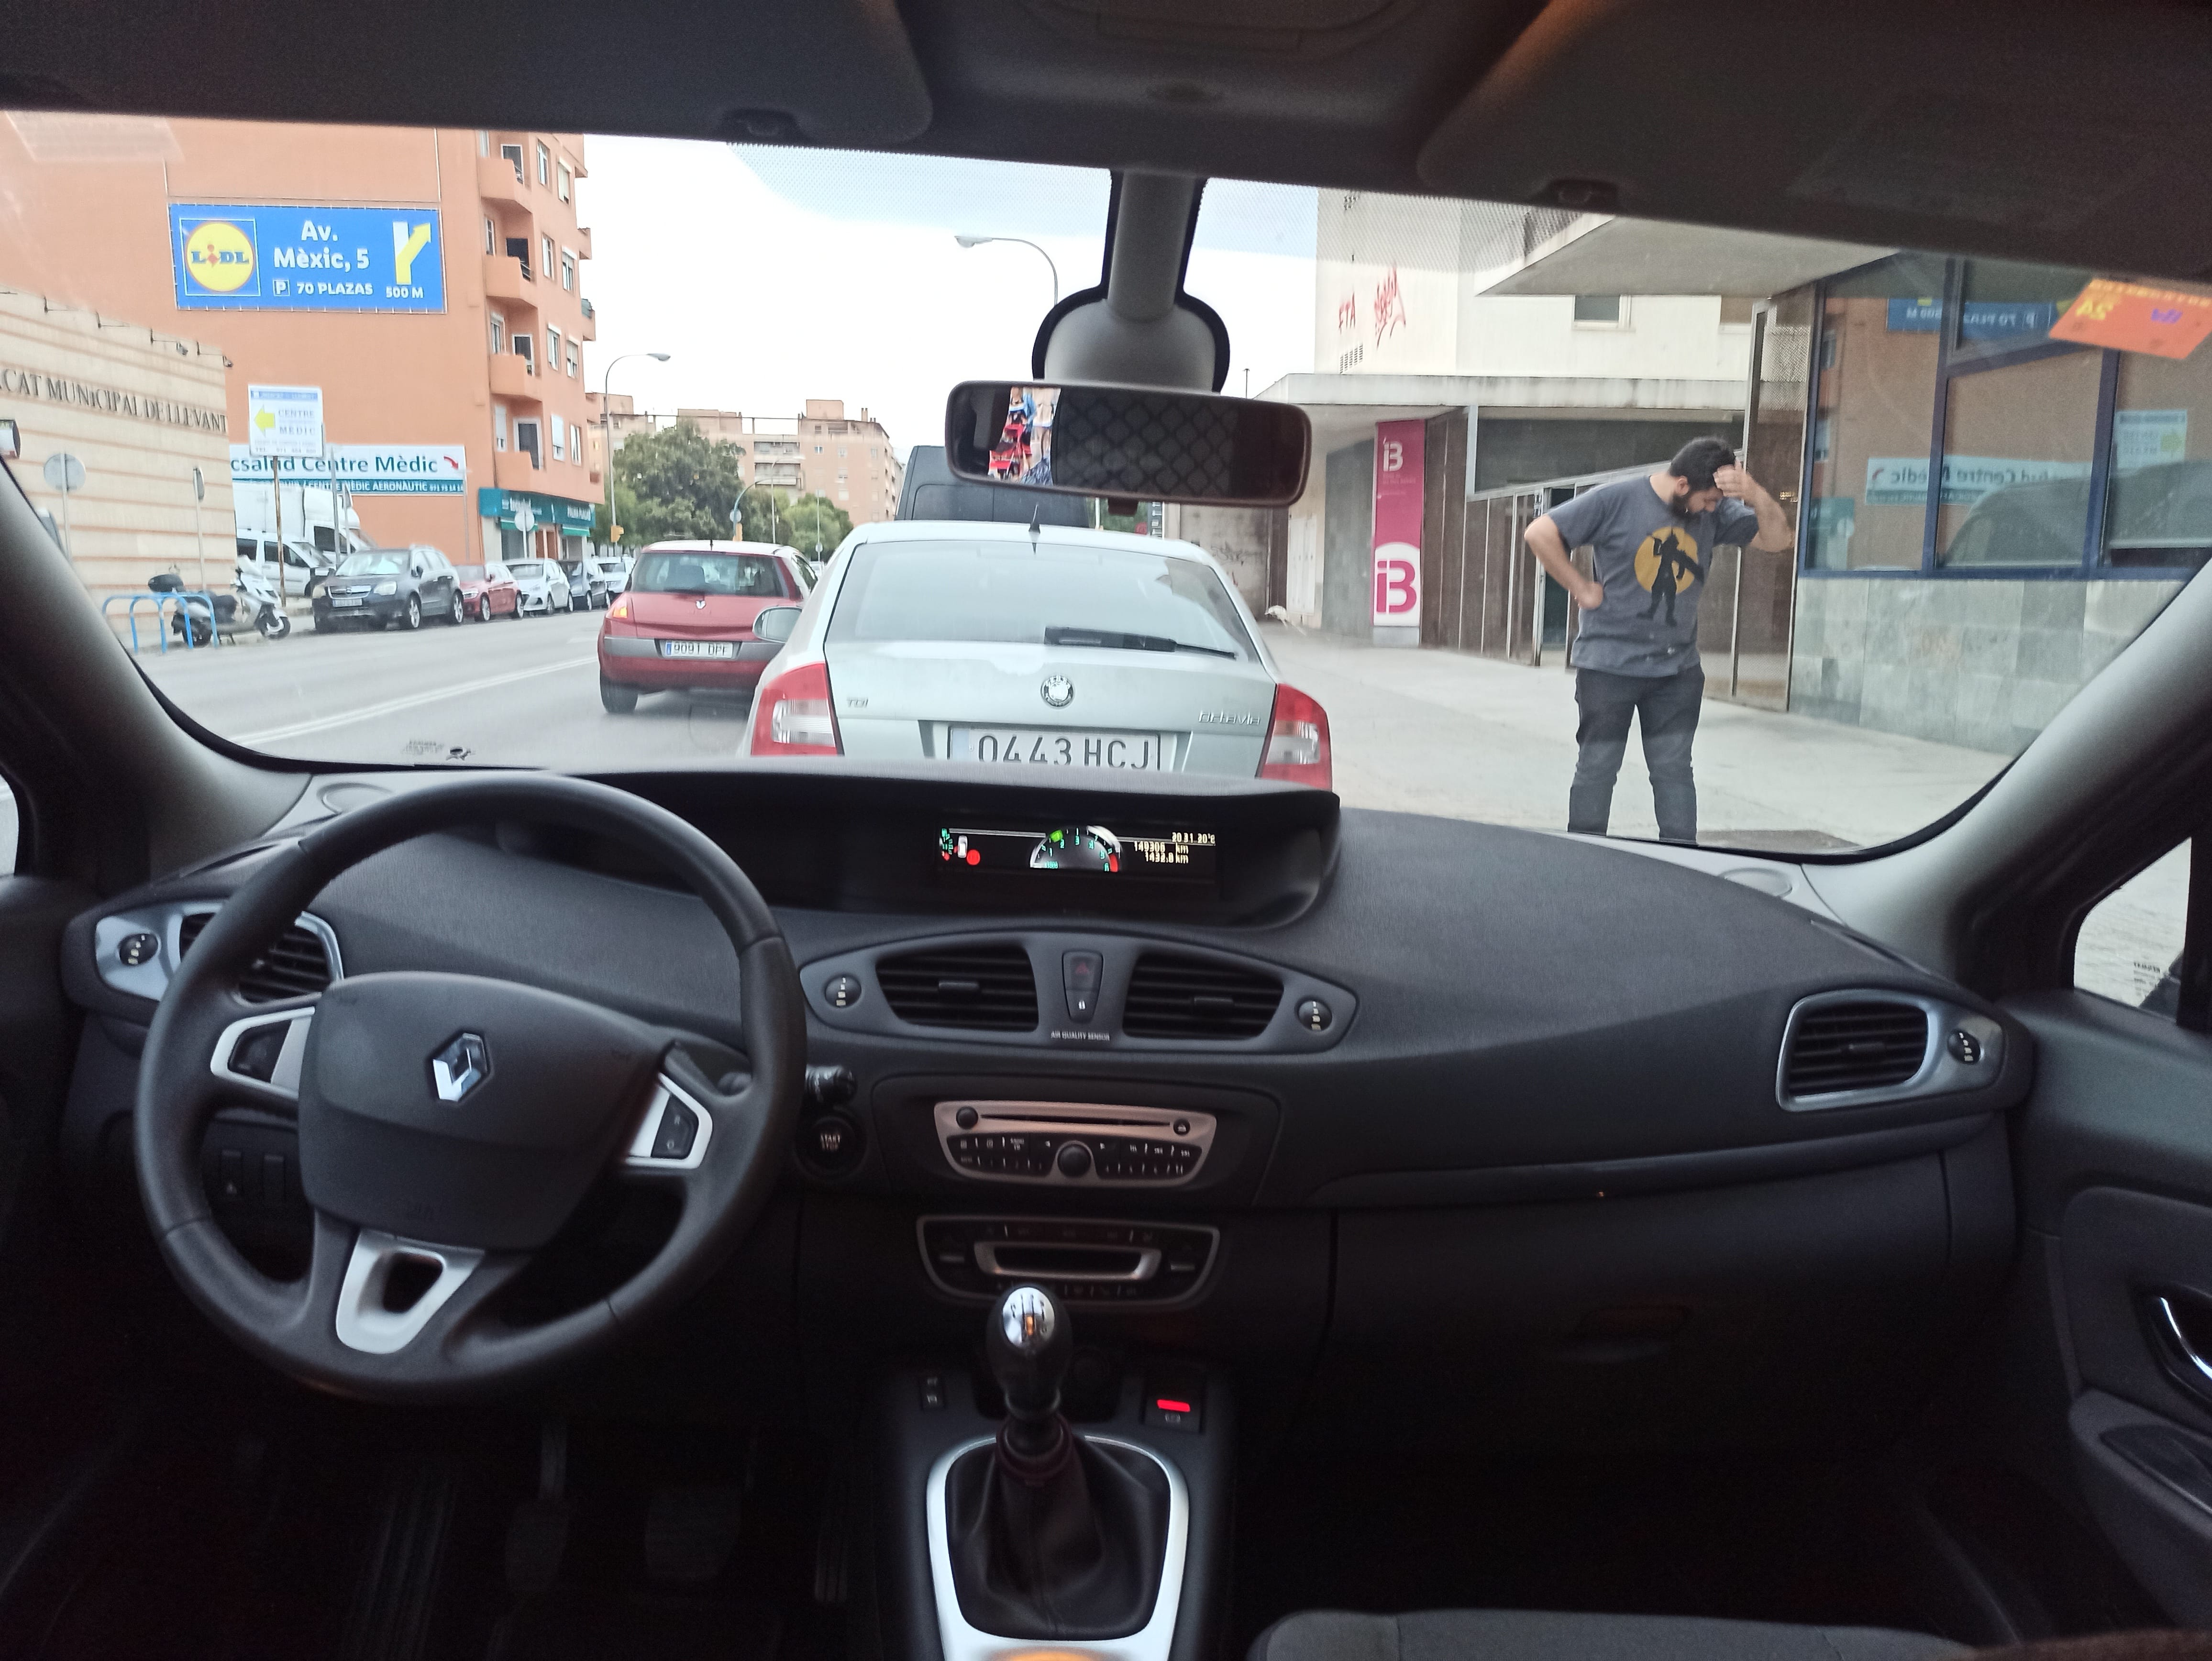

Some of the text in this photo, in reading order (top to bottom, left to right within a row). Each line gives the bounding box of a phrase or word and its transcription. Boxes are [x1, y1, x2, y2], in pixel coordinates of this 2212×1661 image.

[301, 220, 338, 242] Av.
[273, 246, 370, 273] Mèxic, 5
[276, 280, 374, 296] P 70 PLAZAS
[386, 286, 424, 299] 500 M
[0, 368, 42, 396] CAT
[47, 377, 143, 417] MUNICIPAL
[144, 399, 165, 422] DE
[278, 409, 314, 419] CENTRE
[302, 455, 368, 472] Centre
[376, 454, 438, 472] Mèdic
[846, 697, 869, 708] TDI
[978, 734, 1149, 769] 0443 HCJ
[1175, 842, 1189, 854] km
